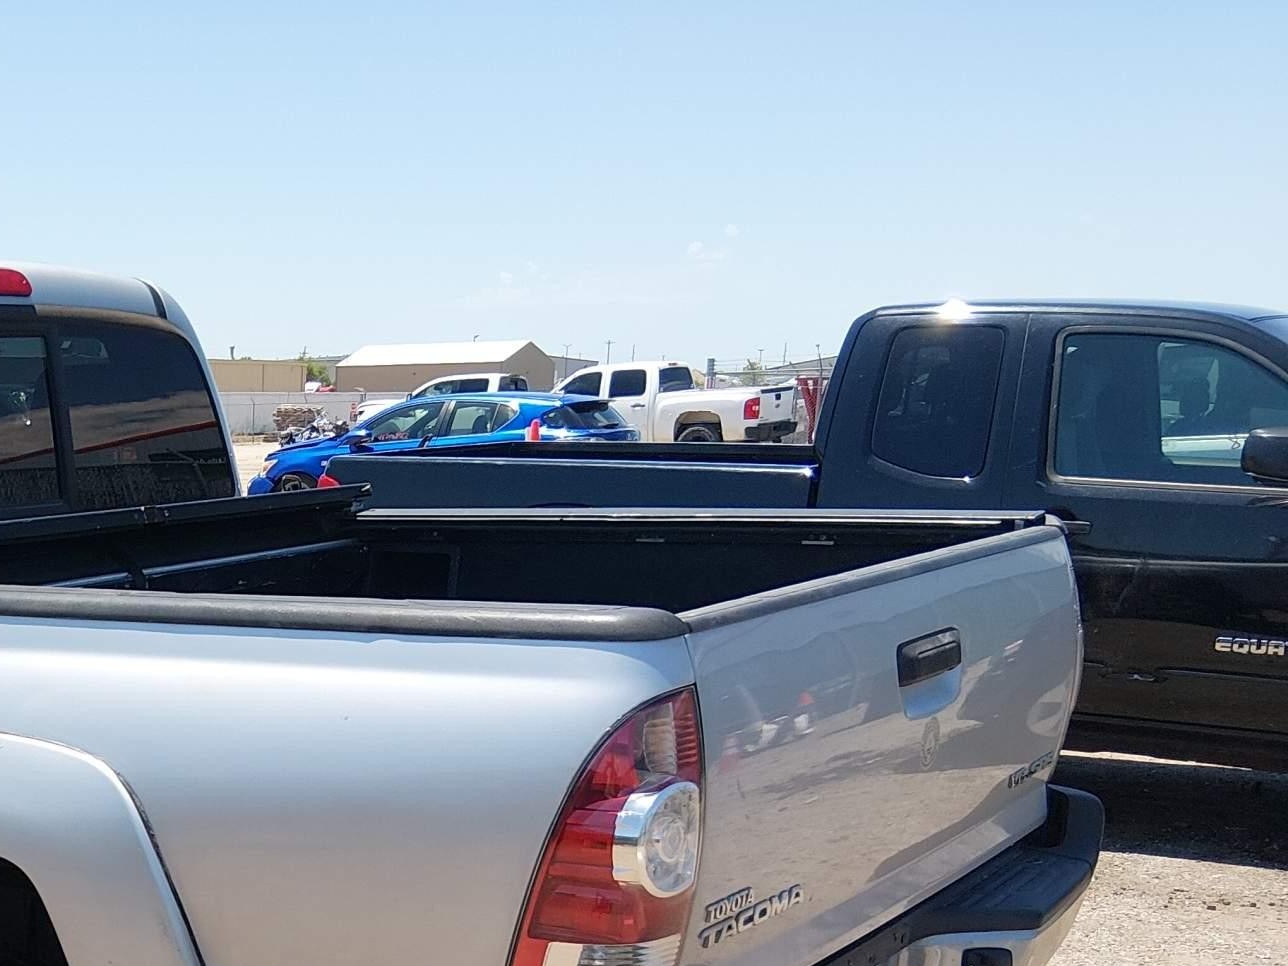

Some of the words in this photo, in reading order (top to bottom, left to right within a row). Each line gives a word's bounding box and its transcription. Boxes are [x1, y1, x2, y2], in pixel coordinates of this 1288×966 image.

[1215, 636, 1288, 656] EQUA
[697, 883, 803, 948] TACOMA
[705, 886, 754, 923] TOYOTA
